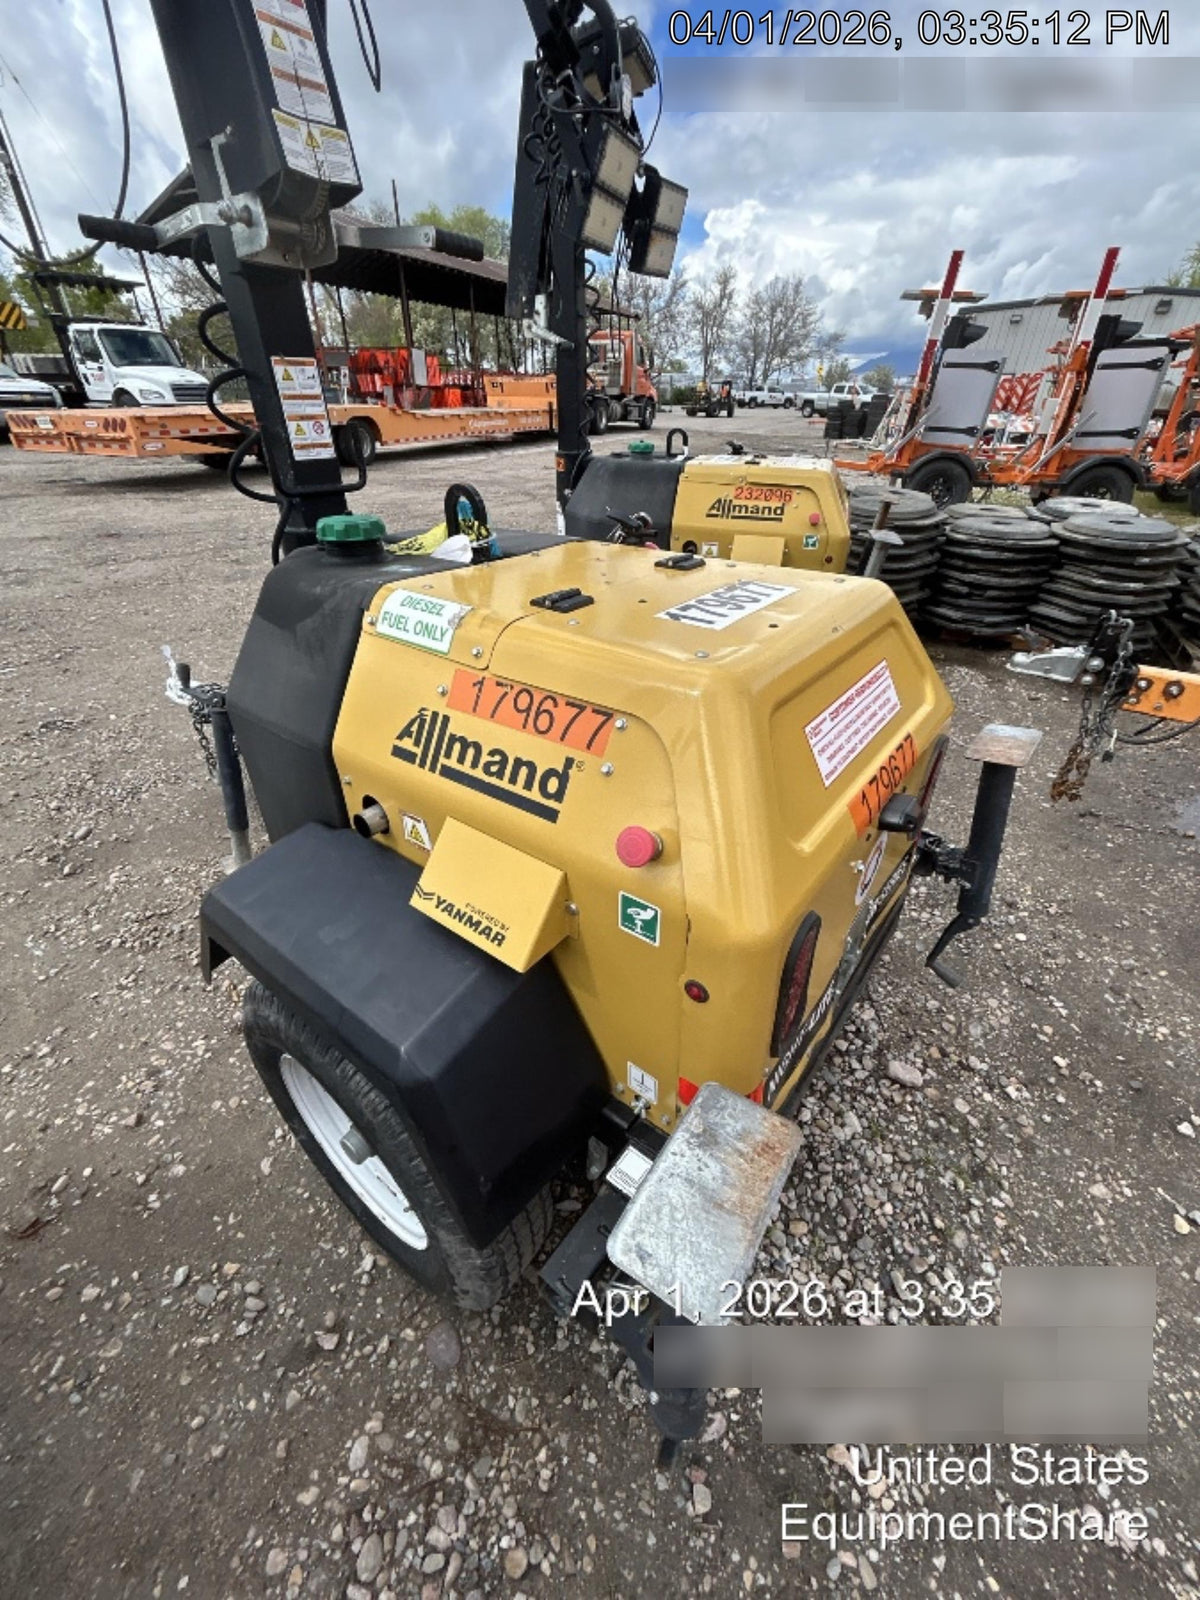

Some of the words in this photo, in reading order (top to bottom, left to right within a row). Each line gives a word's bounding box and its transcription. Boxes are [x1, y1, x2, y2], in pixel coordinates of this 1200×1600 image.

[706, 497, 786, 521] Allmand
[734, 486, 794, 504] 232096
[400, 595, 446, 617] DIESEL
[665, 579, 786, 626] 179677
[381, 611, 410, 634] FUEL
[413, 619, 449, 643] ONLY
[472, 676, 615, 751] 179677
[392, 708, 576, 812] Allmand
[860, 732, 916, 825] 179677
[434, 895, 507, 947] YANMAR
